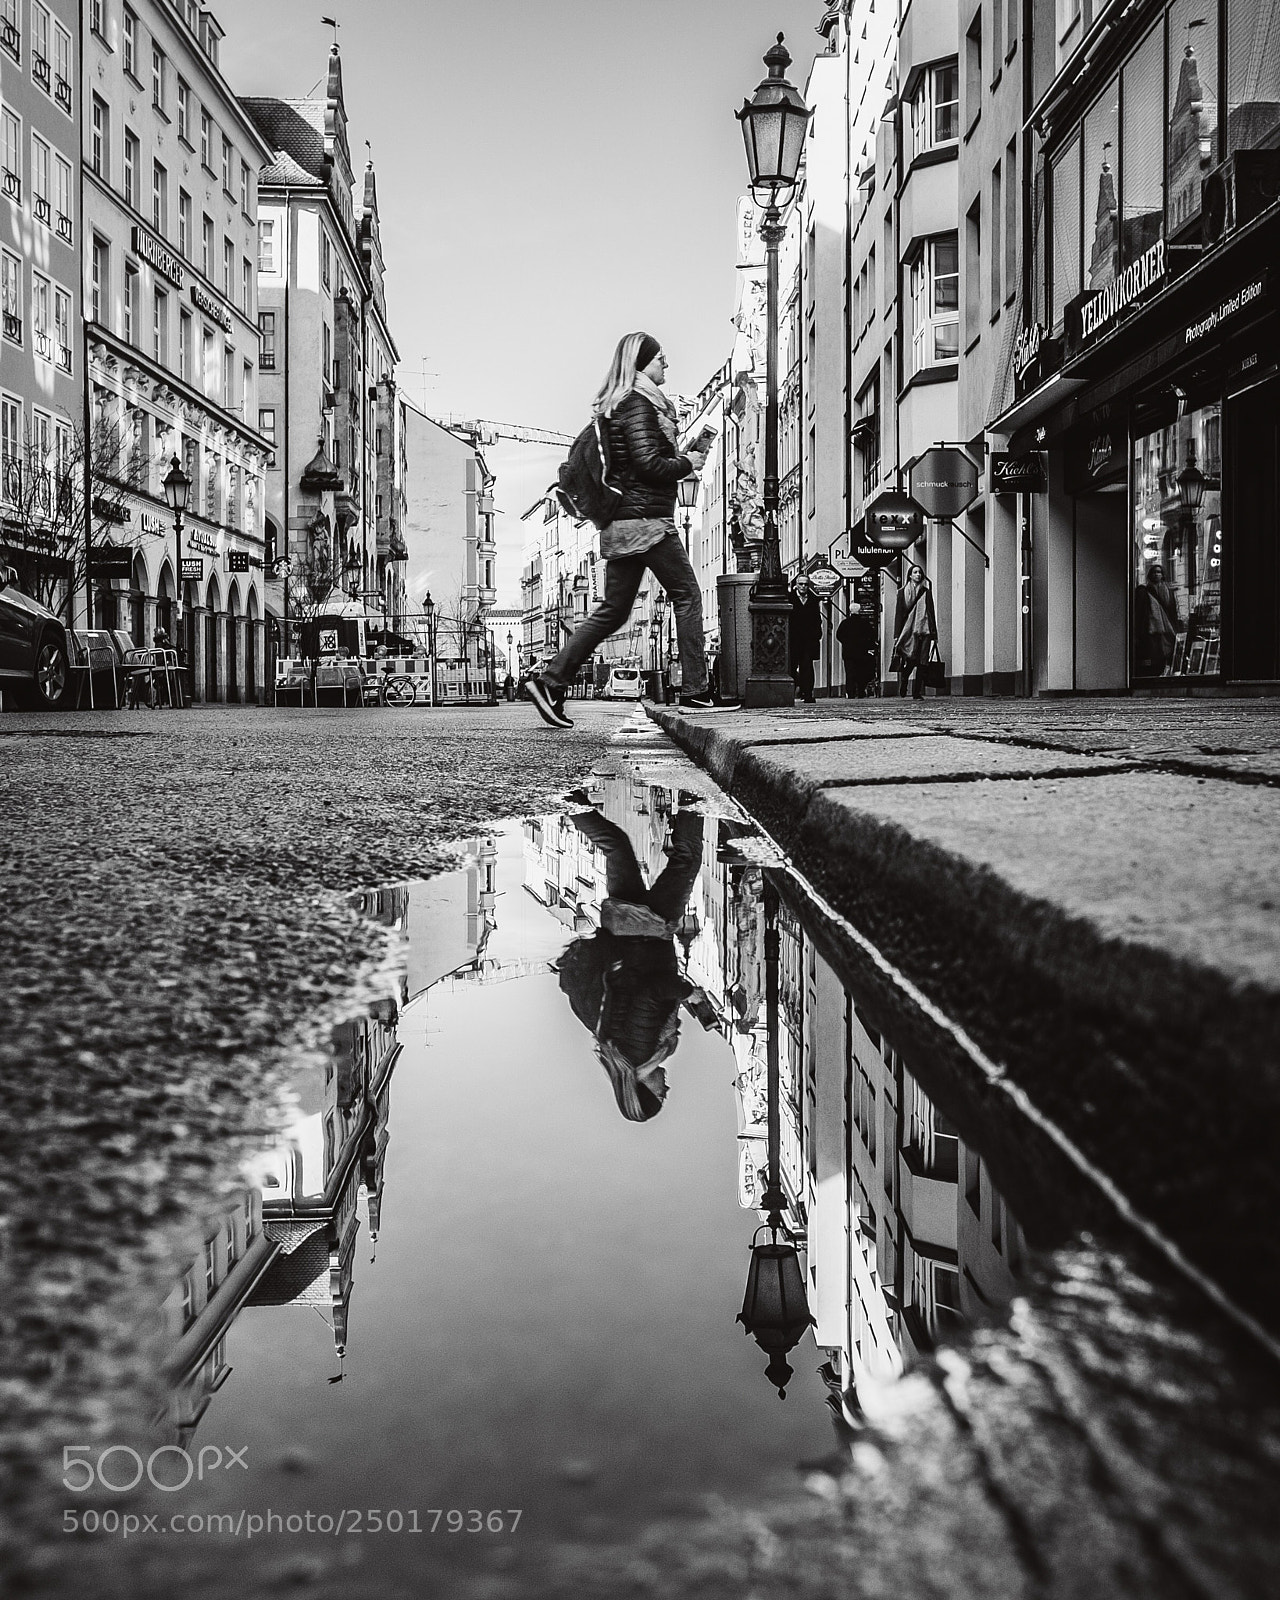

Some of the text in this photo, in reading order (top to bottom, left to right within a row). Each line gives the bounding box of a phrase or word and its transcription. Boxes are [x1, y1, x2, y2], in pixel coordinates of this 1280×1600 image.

[1081, 239, 1165, 339] YELLOWKORNER
[1241, 282, 1262, 306] Edition
[993, 461, 1039, 476] Kiehl's
[143, 512, 161, 535] LUSH
[871, 512, 919, 525] texxt
